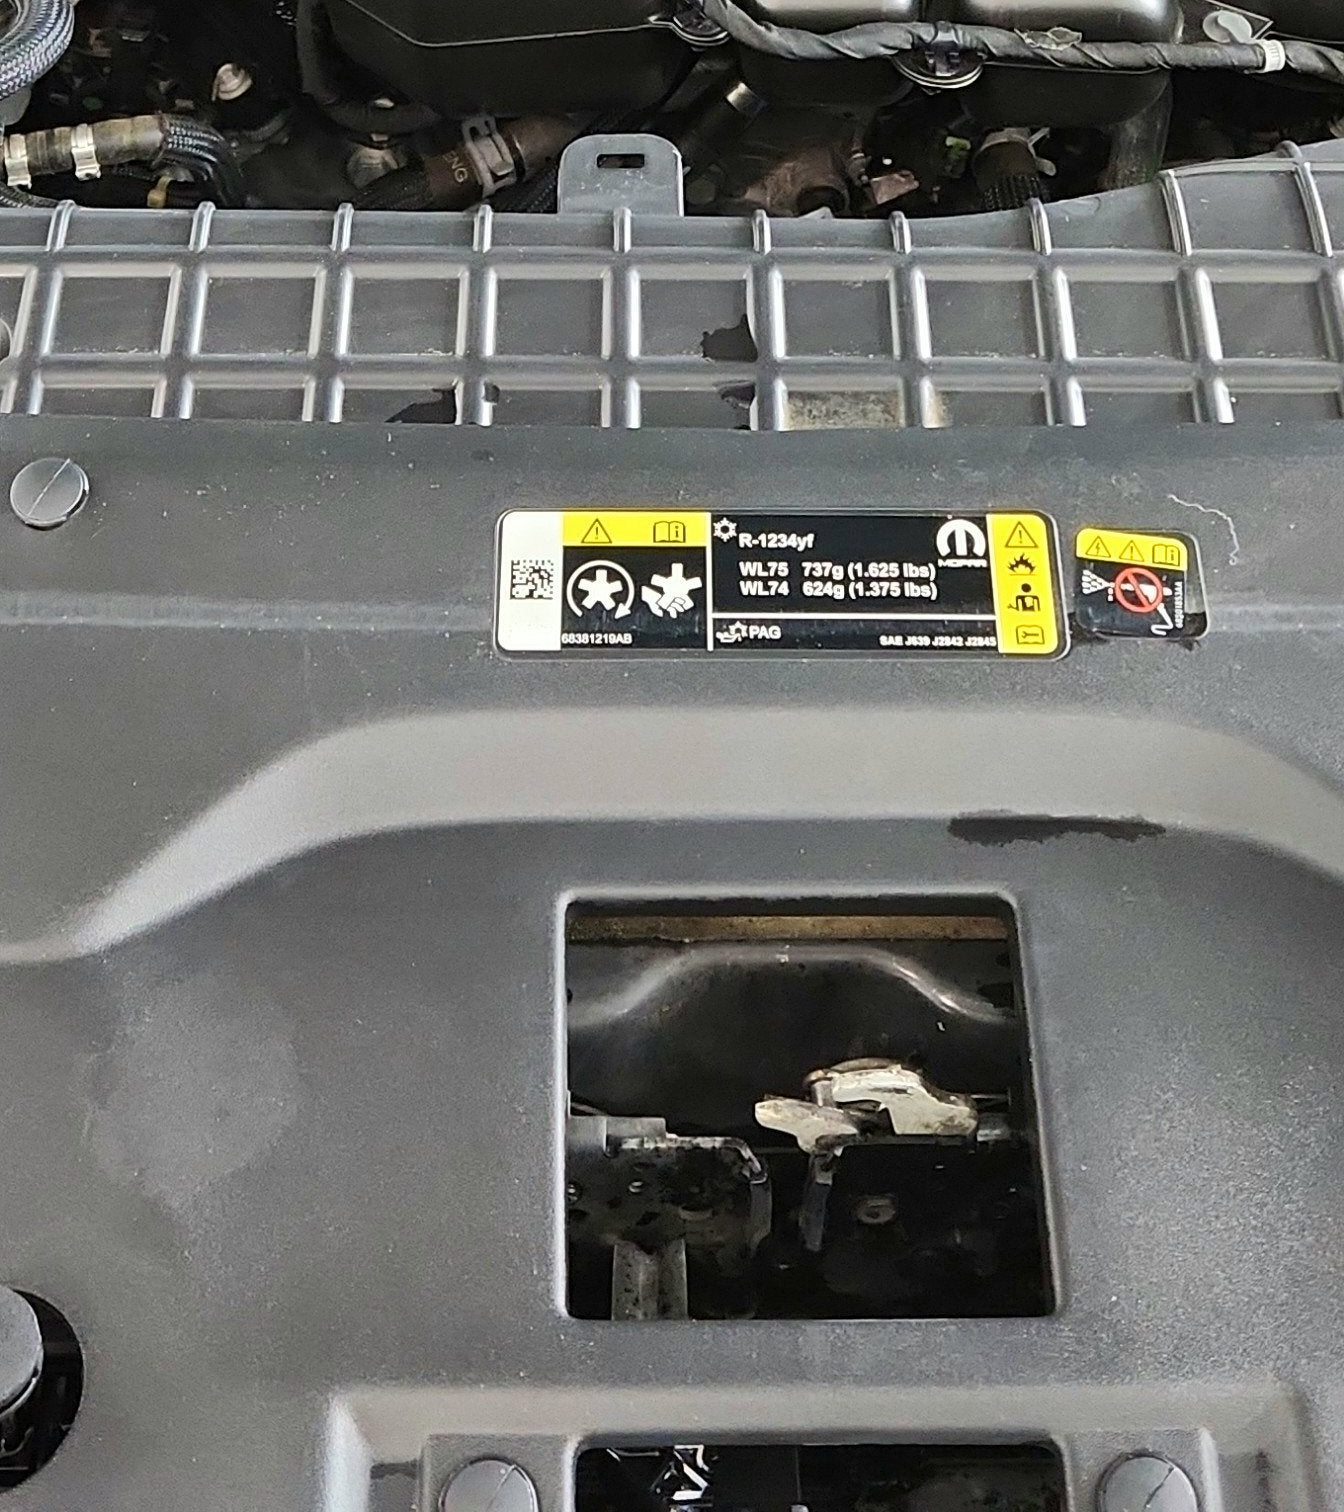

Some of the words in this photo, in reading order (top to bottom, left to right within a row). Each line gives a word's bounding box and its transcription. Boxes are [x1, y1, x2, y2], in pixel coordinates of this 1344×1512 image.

[739, 533, 815, 551] R-1234yf
[739, 561, 790, 577] WL75
[802, 562, 845, 580] 737g
[848, 562, 900, 581] (1.625
[903, 562, 937, 581] lbs)
[739, 580, 790, 596] WL74
[802, 581, 845, 600] 624g
[849, 581, 901, 600] (1.375
[903, 581, 938, 601] lbs)
[749, 625, 782, 640] PAG
